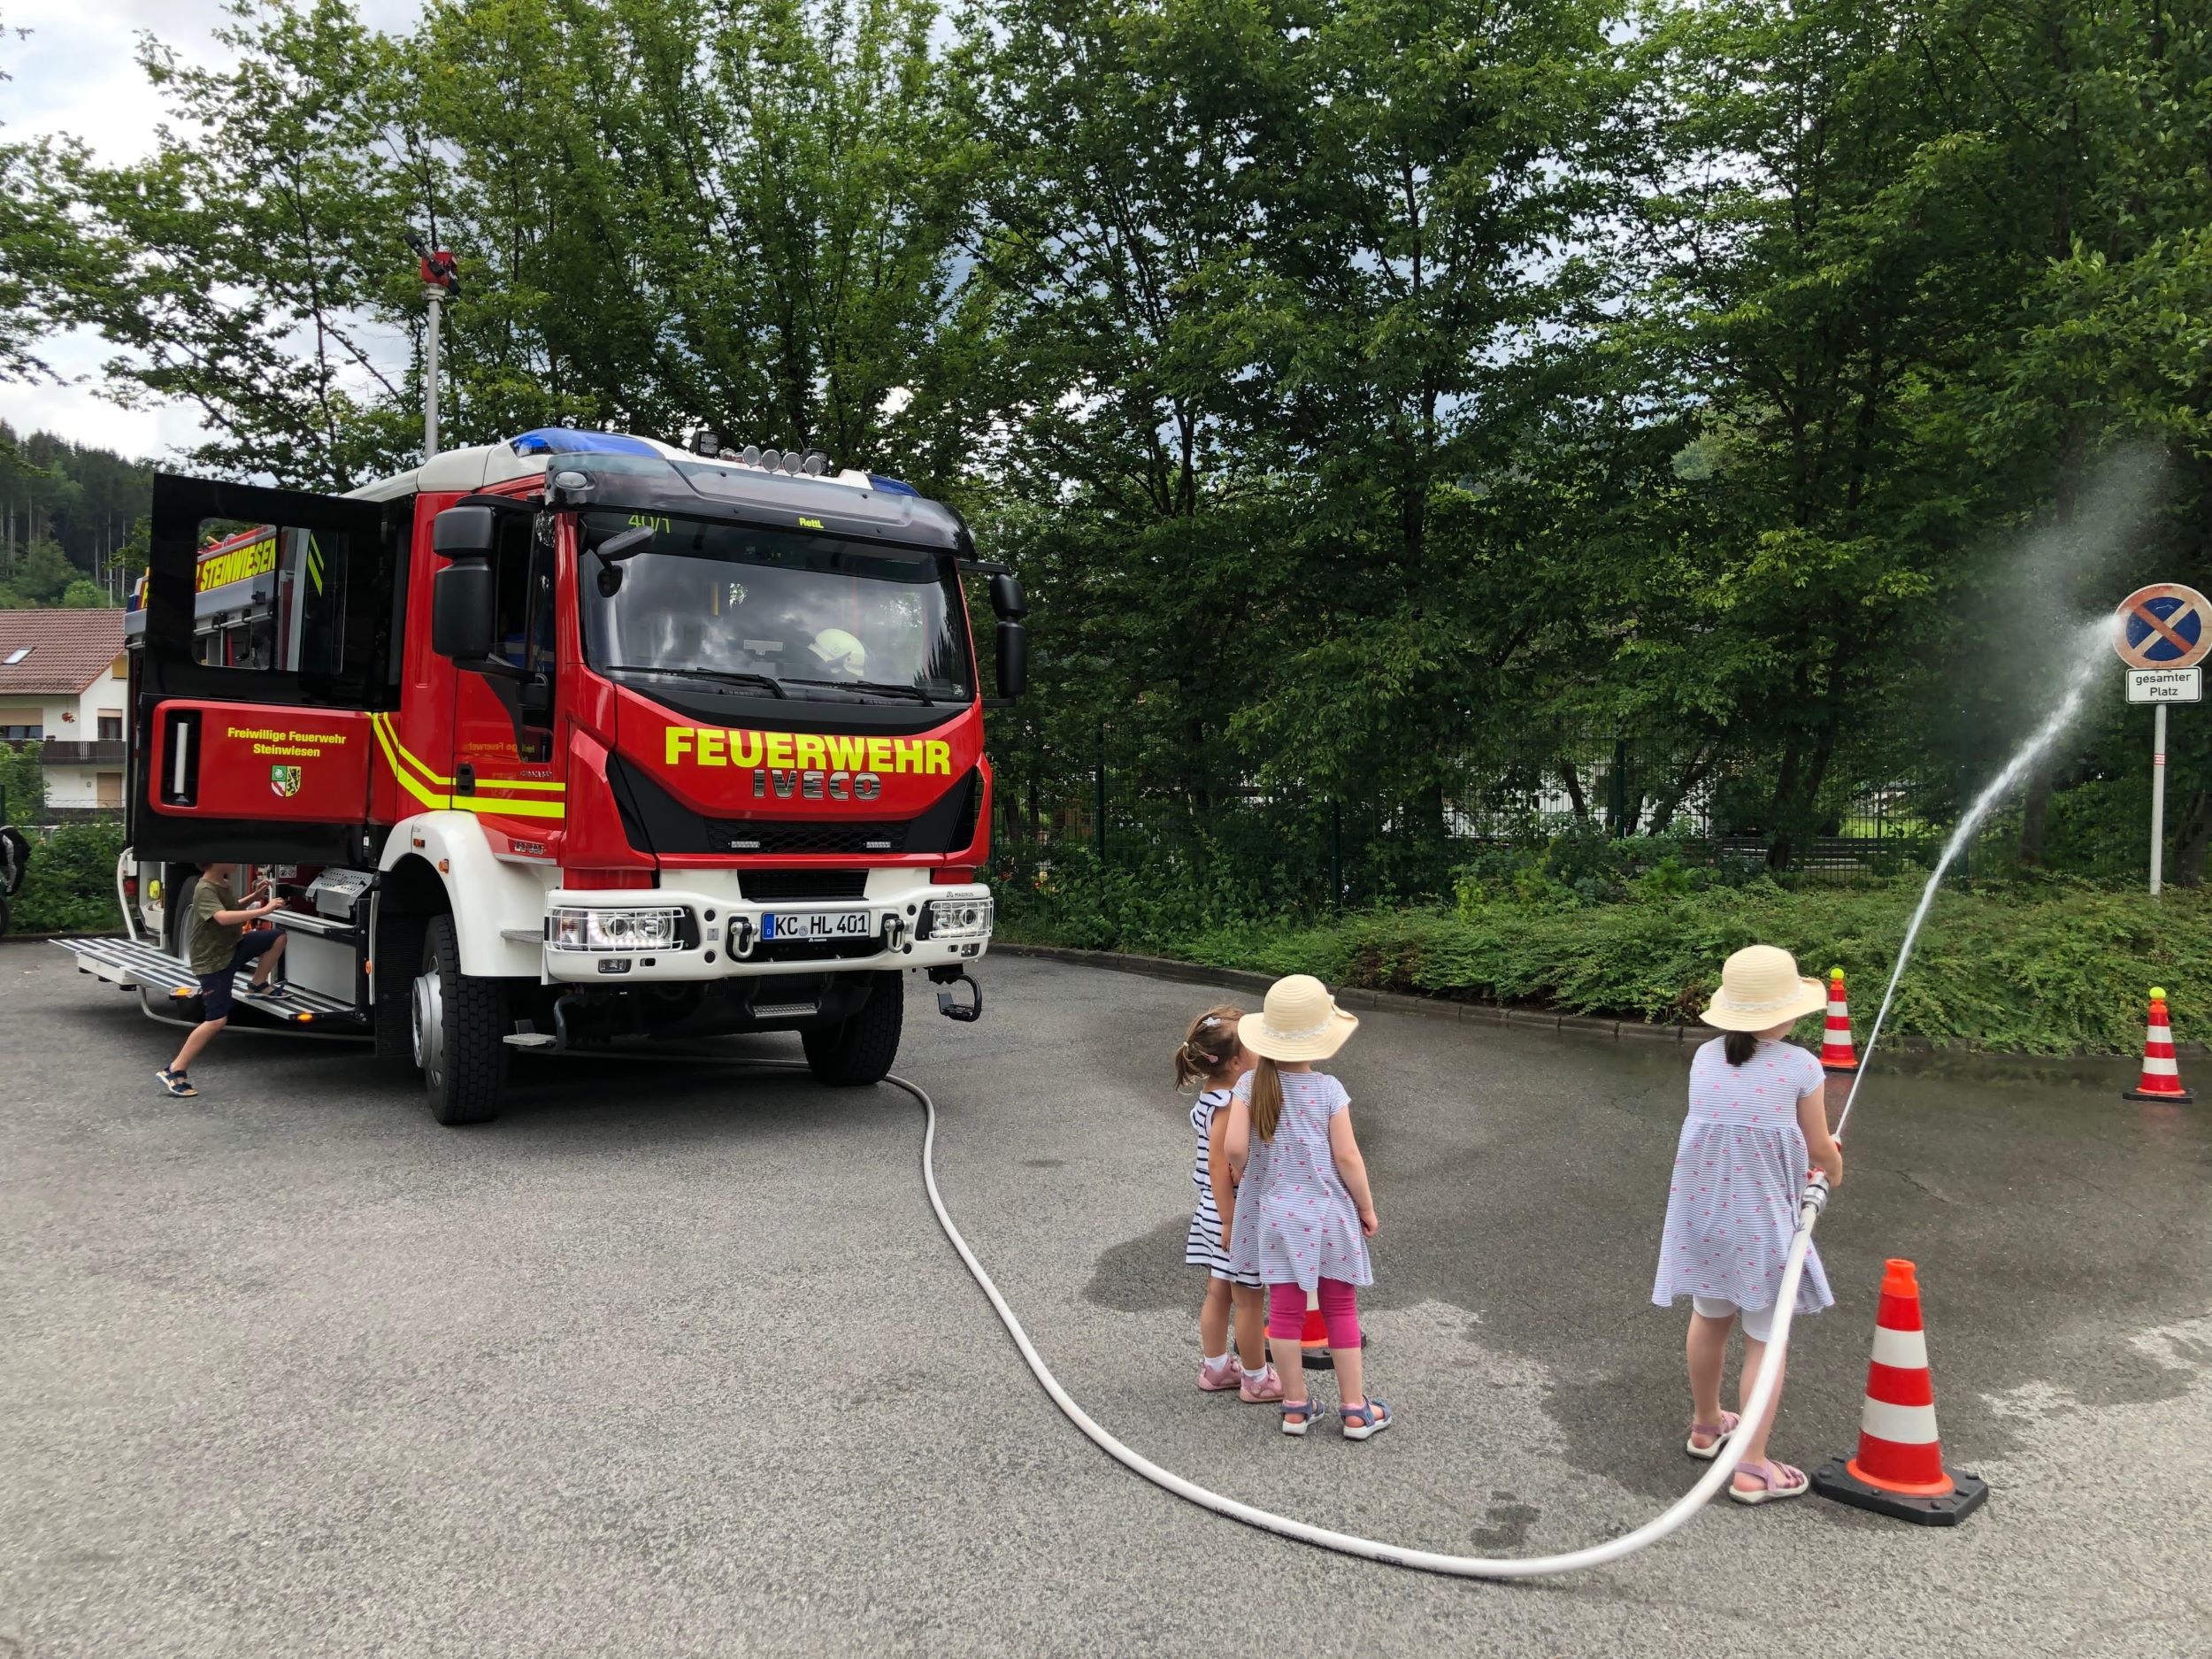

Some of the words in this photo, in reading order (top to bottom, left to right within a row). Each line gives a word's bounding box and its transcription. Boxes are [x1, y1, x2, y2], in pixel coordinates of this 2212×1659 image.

[200, 537, 276, 591] STEINWIESEN
[2136, 673, 2191, 686] gesamter
[2150, 687, 2178, 696] Platz
[227, 726, 286, 741] Freiwillige
[288, 731, 347, 744] Feuerwehr
[253, 743, 320, 757] Steinwiesen
[665, 726, 951, 775] FEUERWEHR
[753, 769, 881, 801] IVECO
[775, 917, 797, 936] KC
[810, 916, 833, 934] HL
[836, 915, 867, 933] 401
